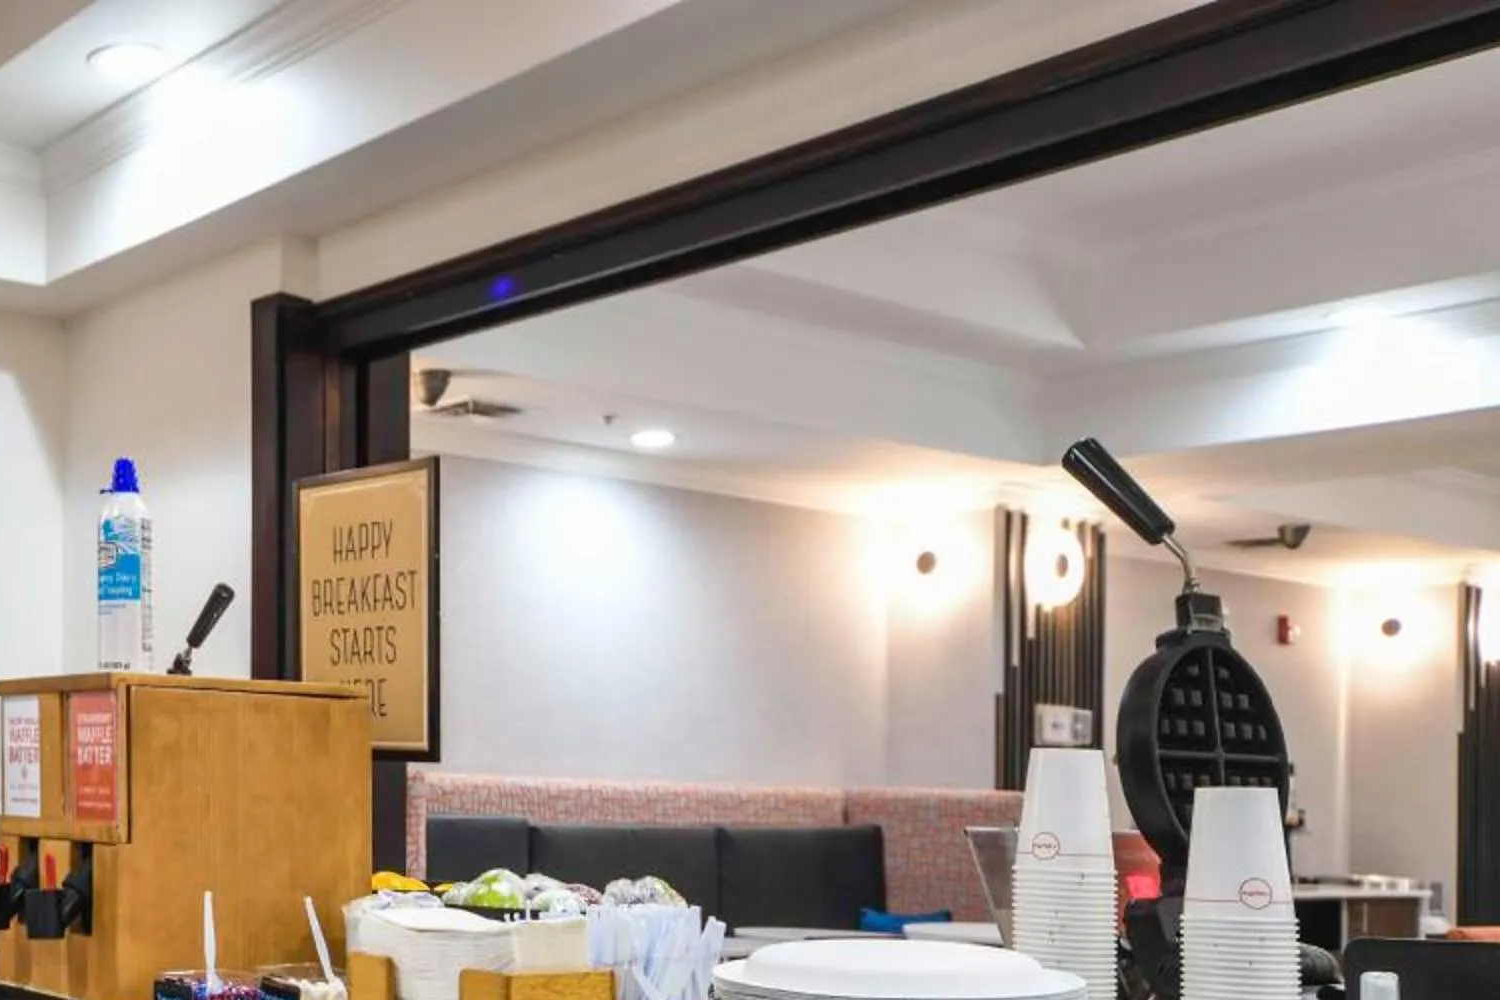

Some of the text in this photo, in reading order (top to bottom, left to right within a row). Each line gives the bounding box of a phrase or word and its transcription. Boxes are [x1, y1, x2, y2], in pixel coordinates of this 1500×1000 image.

[332, 519, 393, 564] HAPPY
[311, 570, 417, 617] BREAKFAST
[329, 626, 397, 666] STARTS
[77, 726, 113, 744] WAFFLE
[77, 744, 113, 766] BATTER
